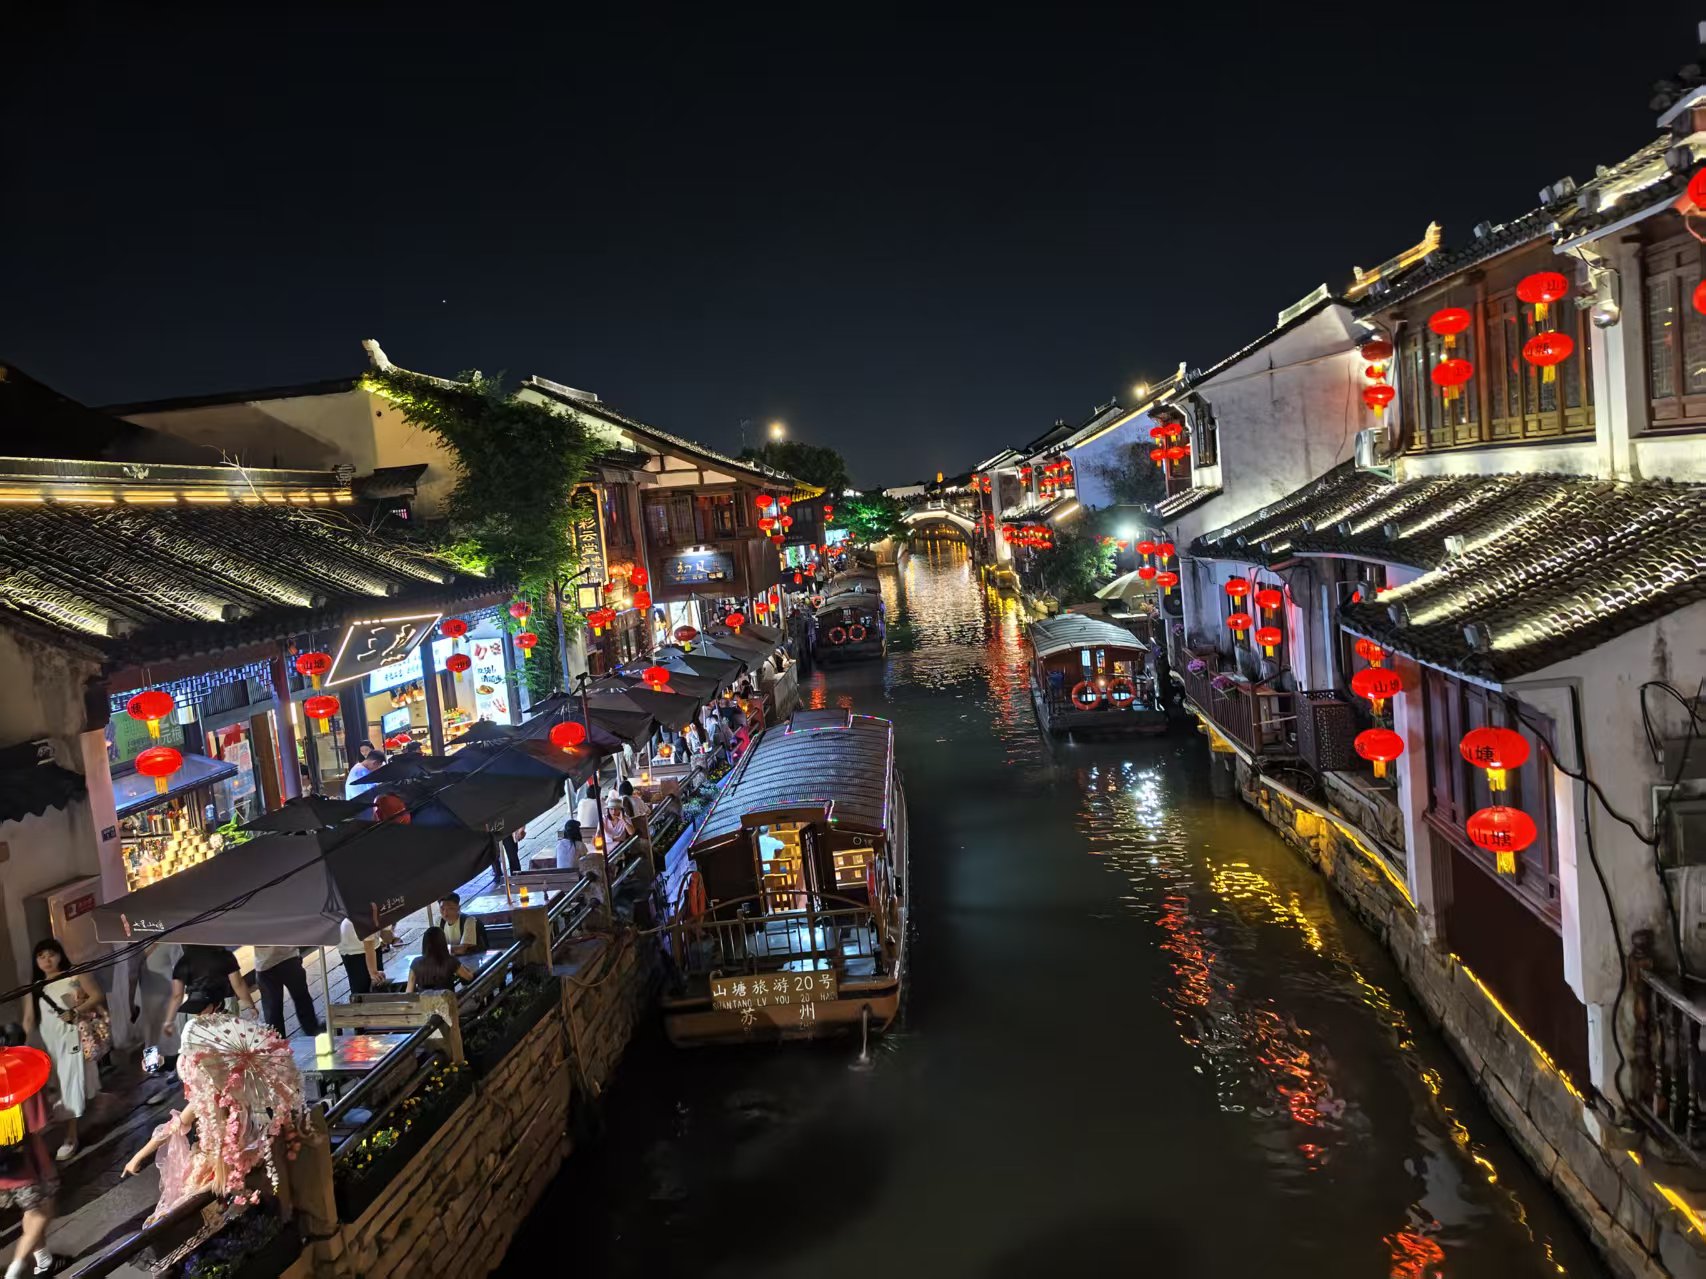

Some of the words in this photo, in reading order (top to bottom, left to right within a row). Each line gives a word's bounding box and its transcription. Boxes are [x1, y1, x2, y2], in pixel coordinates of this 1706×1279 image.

[1473, 829, 1512, 847] 山塘
[713, 974, 833, 997] 山塘旅游20号
[756, 996, 767, 1007] LV
[774, 995, 791, 1005] YOU
[801, 993, 811, 1003] 20
